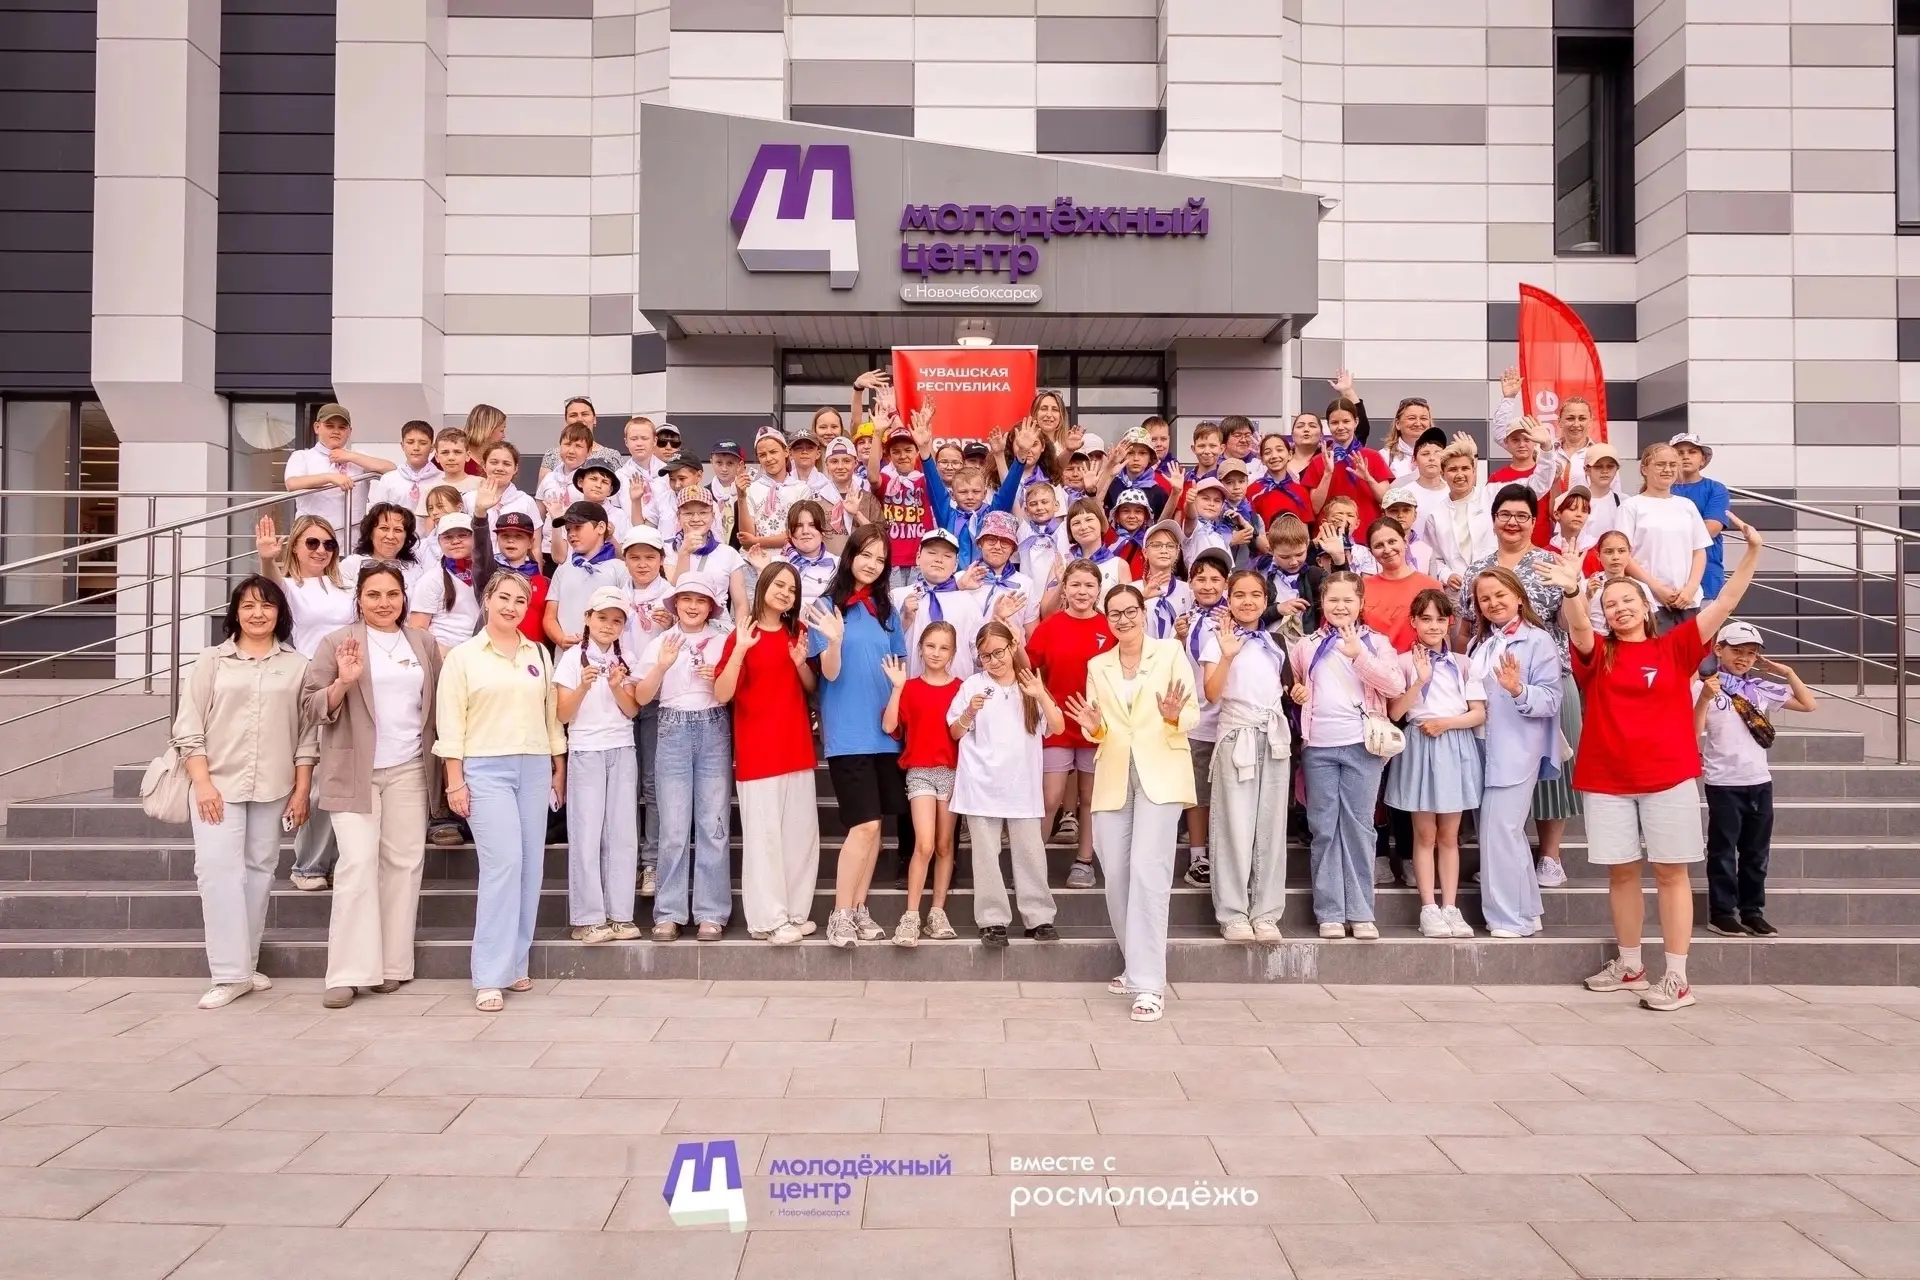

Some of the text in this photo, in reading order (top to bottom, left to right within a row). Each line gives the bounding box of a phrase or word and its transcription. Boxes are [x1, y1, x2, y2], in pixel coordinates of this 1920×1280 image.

[900, 196, 1209, 241] молодёжный
[901, 242, 1039, 284] центр
[904, 284, 1038, 302] г. Новочебоксарск
[919, 367, 1009, 378] ЧУВАШСКАЯ
[916, 381, 1011, 392] РЕСПУБЛИКА
[884, 486, 924, 506] UST
[884, 504, 925, 523] KEEP
[888, 522, 926, 539] OING
